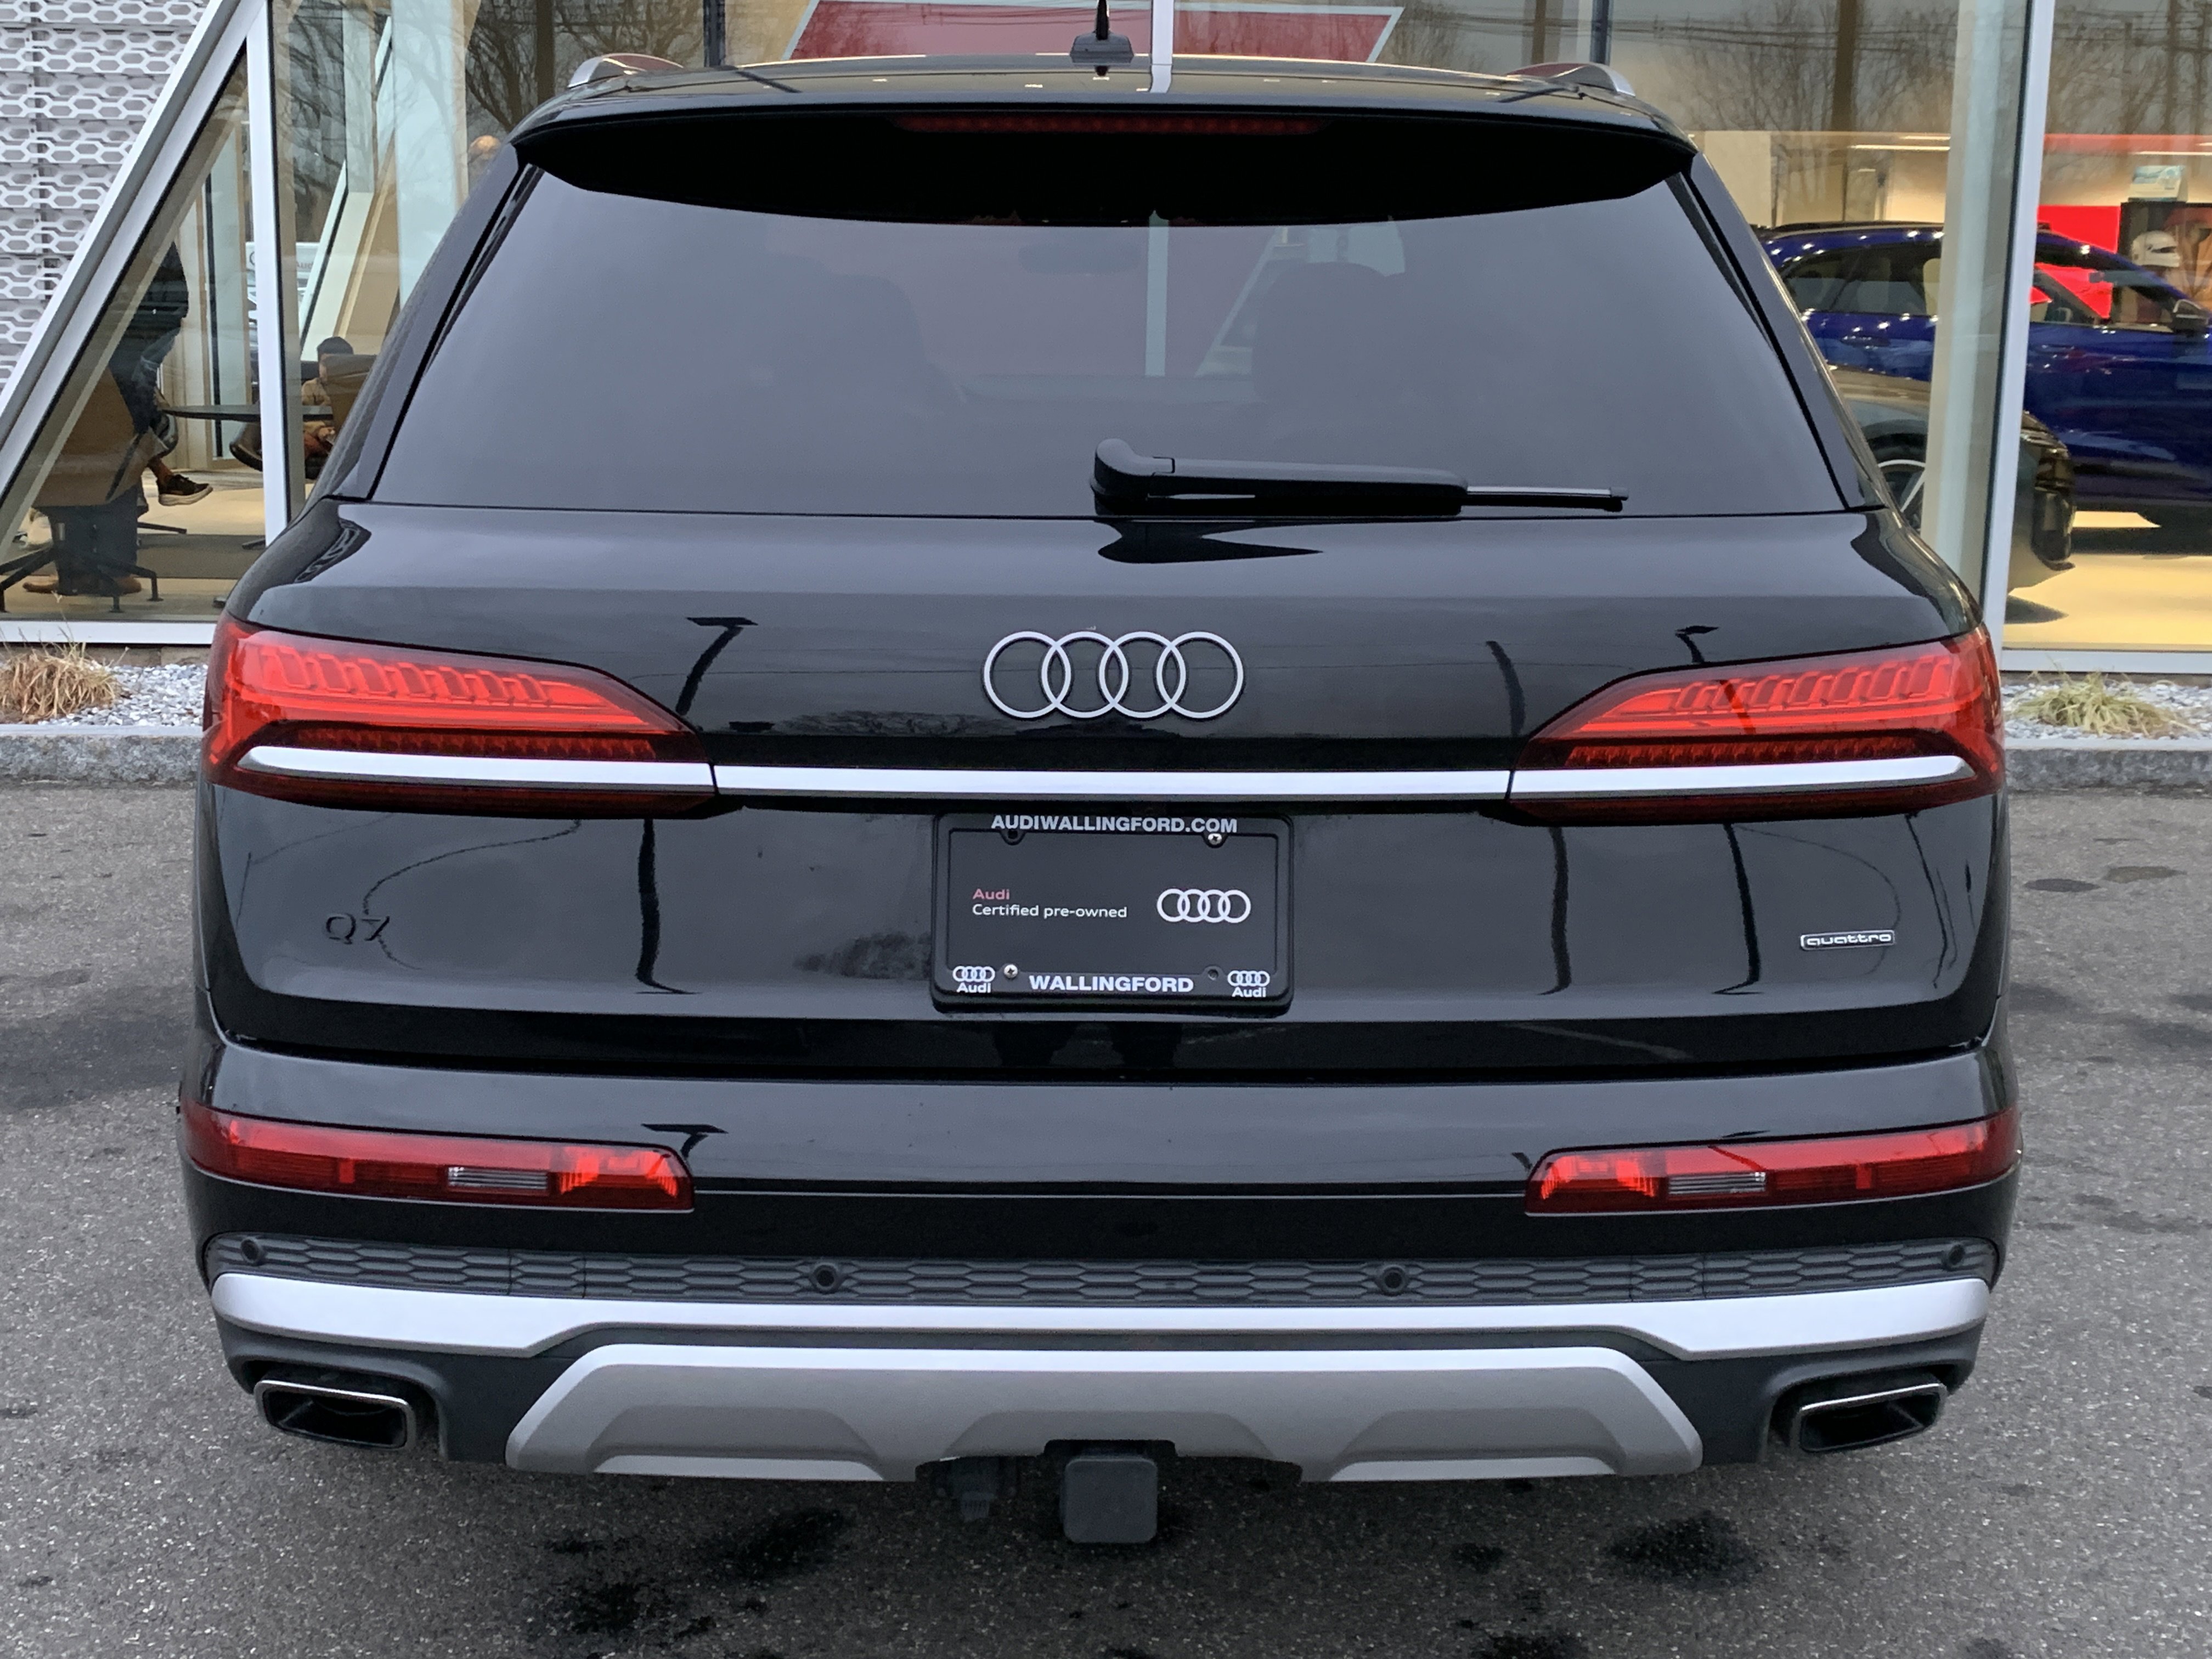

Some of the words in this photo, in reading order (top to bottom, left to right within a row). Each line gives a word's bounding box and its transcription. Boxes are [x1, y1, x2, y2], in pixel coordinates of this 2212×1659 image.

[991, 815, 1238, 833] AUDIWALLINGFORD.COM
[972, 889, 1011, 900] Audi
[972, 904, 1039, 917] Certified
[1043, 905, 1127, 919] pre-owned
[326, 913, 391, 945] Q7
[1807, 934, 1892, 946] quattro
[957, 981, 991, 994] Audi
[1030, 975, 1194, 992] WALLINGFORD
[1232, 986, 1266, 998] Audi
